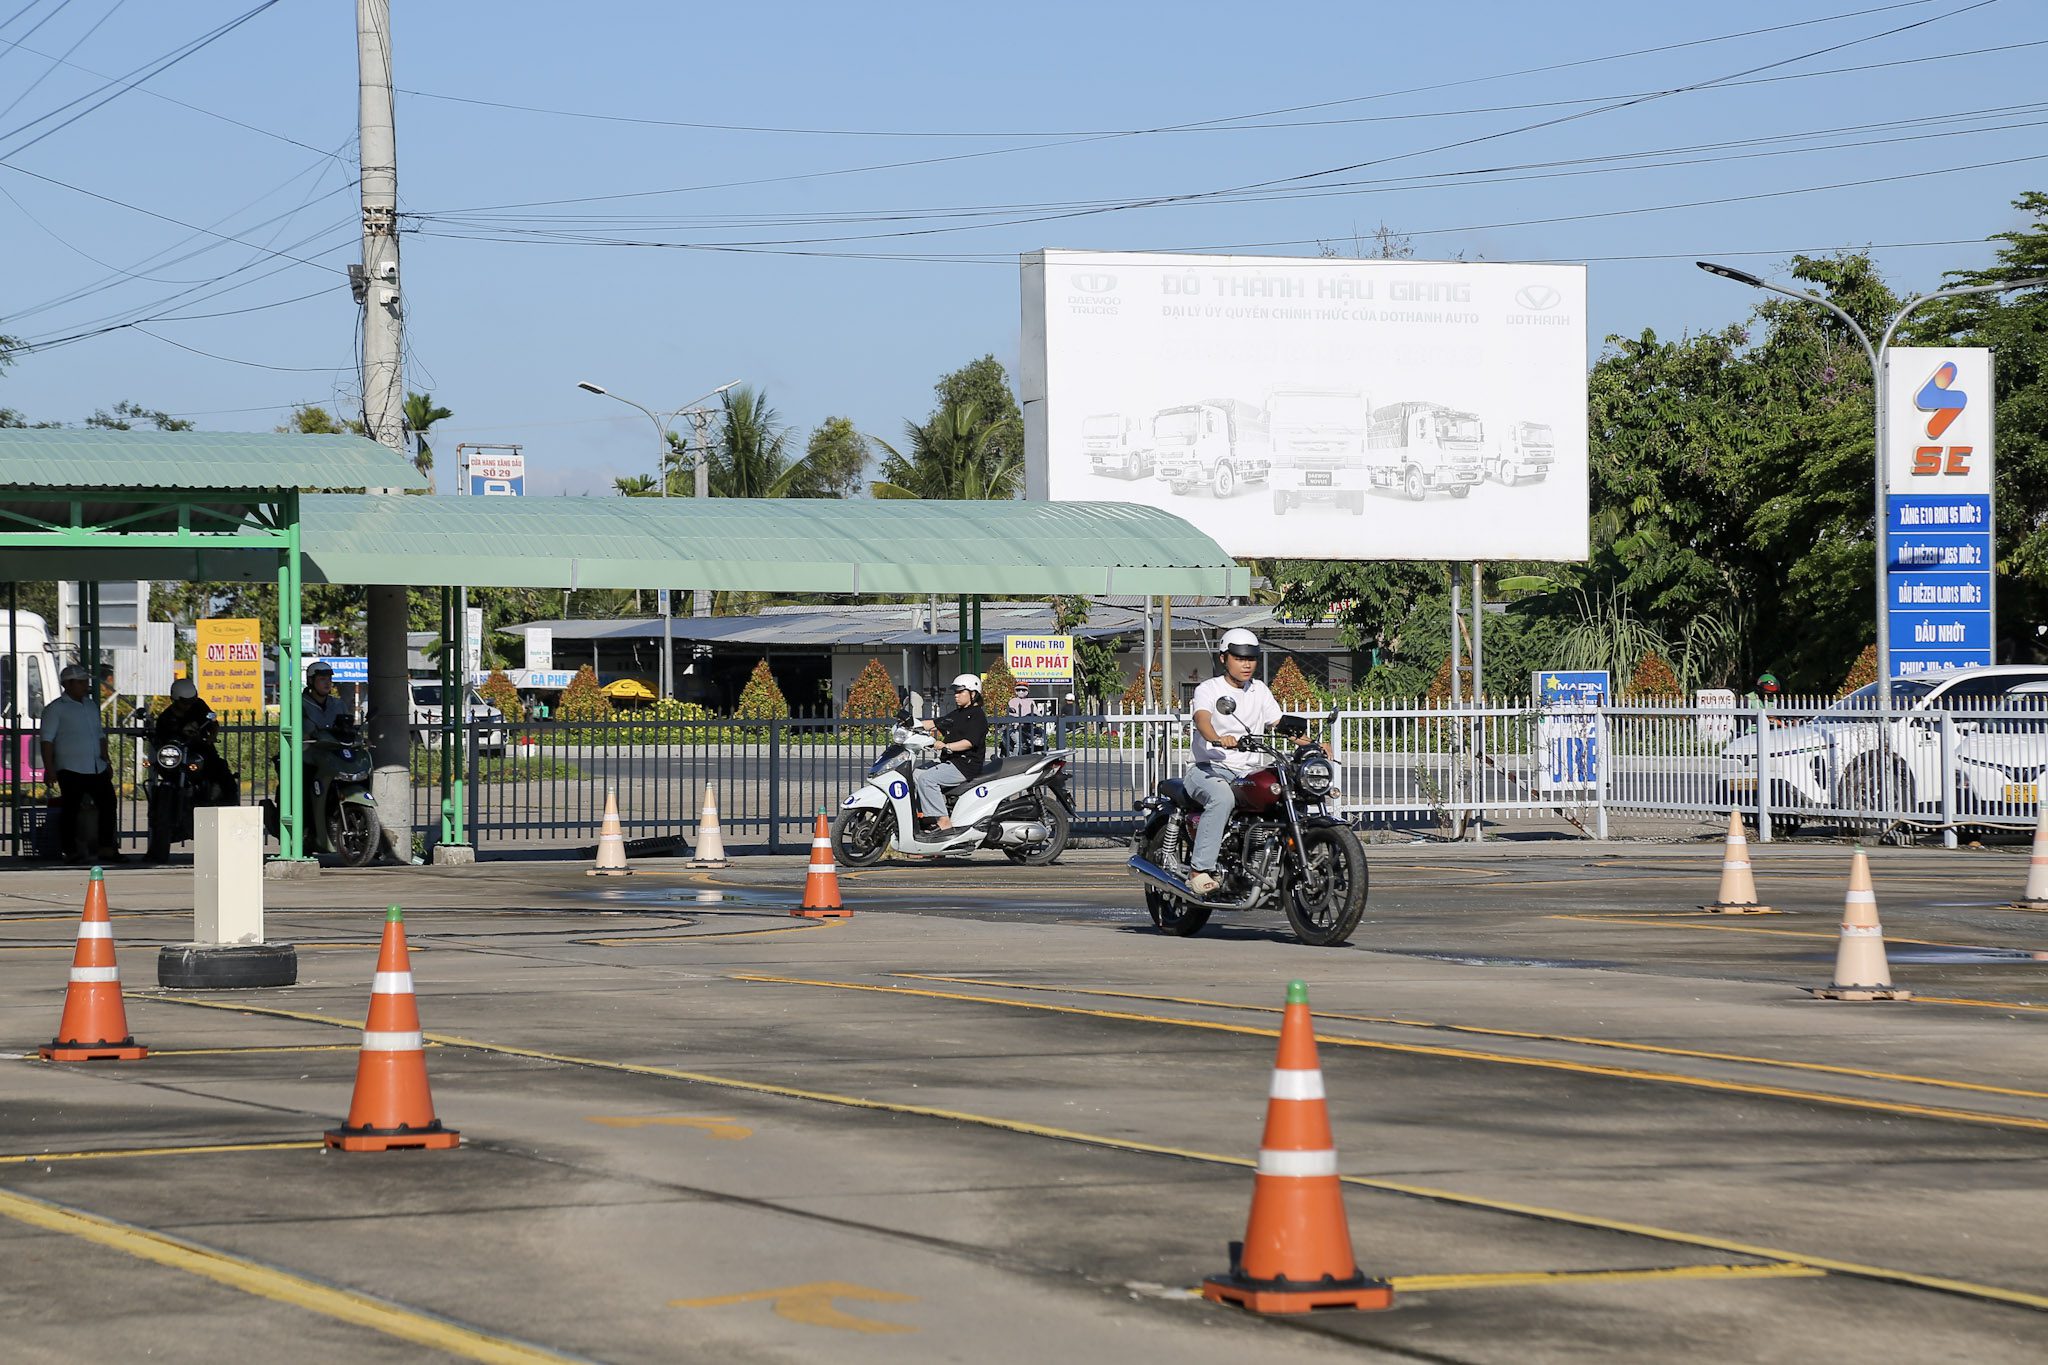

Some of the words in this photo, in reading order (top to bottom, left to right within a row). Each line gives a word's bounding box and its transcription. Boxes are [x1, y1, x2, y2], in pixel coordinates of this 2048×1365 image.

[1212, 270, 1305, 298] THÀNH
[1317, 272, 1374, 306] HẬU
[1389, 279, 1472, 303] GIANG
[1067, 296, 1121, 305] DAEWOO
[1071, 306, 1119, 315] TRUCKS
[1162, 305, 1185, 320] ĐẠI
[1187, 304, 1202, 317] LÝ
[1271, 304, 1312, 320] CHÍNH
[1315, 306, 1348, 321] THỨC
[1379, 311, 1442, 324] DOTHANH
[1445, 312, 1480, 325] AUTO
[1911, 446, 1974, 476] SE
[498, 469, 511, 478] 29
[1900, 503, 1919, 525] XĂNG
[1934, 506, 1949, 524] RON
[1949, 506, 1959, 524] 95
[1959, 502, 1975, 524] MỨC
[1975, 506, 1982, 523] 3
[1959, 543, 1975, 564] MỨC
[1975, 547, 1981, 564] 2
[1960, 582, 1975, 603] MỨC
[1975, 585, 1981, 603] 5
[1915, 619, 1936, 642] DẦU
[1938, 621, 1965, 642] NHỚT
[1011, 656, 1032, 668] GIA
[1037, 653, 1069, 668] PHÁT
[1557, 683, 1602, 691] MADIN
[893, 783, 904, 798] 6
